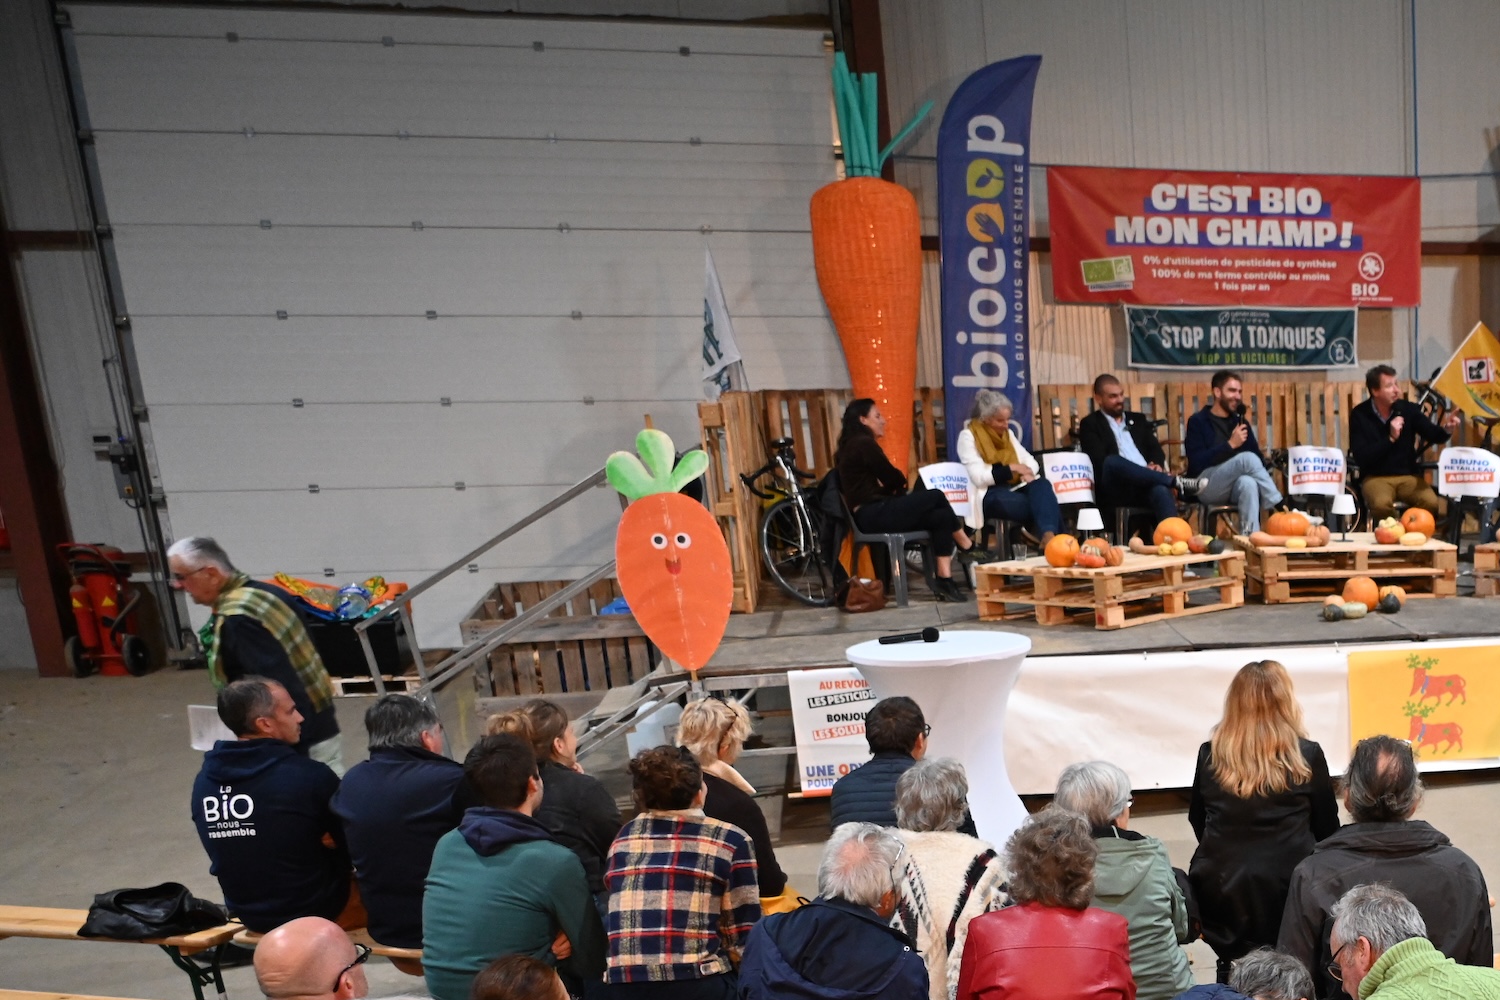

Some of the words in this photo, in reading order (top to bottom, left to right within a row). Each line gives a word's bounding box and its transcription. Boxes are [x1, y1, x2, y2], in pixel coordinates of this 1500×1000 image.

[1151, 183, 1252, 213] C'EST
[1259, 186, 1322, 215] BIO
[1013, 164, 1023, 270] RASSEMBLE
[1114, 216, 1199, 245] MON
[952, 115, 1024, 389] biocoop
[1143, 255, 1161, 265] 0%
[1163, 257, 1219, 266] d'utilisation
[1221, 257, 1232, 267] de
[1234, 257, 1281, 268] pesticides
[1282, 259, 1295, 268] de
[1296, 259, 1337, 270] synthèse
[1152, 268, 1182, 278] 100%
[1184, 269, 1196, 279] de
[1214, 270, 1242, 280] ferme
[1244, 271, 1288, 281] contrôlée
[1289, 273, 1300, 281] au
[1302, 272, 1330, 282] moins
[1214, 282, 1220, 290] 1
[1222, 282, 1239, 291] fois
[1241, 284, 1256, 292] par
[1258, 284, 1270, 292] an
[1352, 283, 1379, 296] BIO
[1014, 279, 1023, 323] NOUS
[1162, 326, 1204, 349] STOP
[1210, 326, 1242, 349] AUX
[1247, 326, 1326, 350] TOXIQUES
[1015, 332, 1024, 361] BIO
[1225, 352, 1236, 364] DE
[1242, 352, 1287, 364] VICTIMES
[1017, 370, 1025, 389] LA
[1293, 457, 1342, 466] MARINE
[1450, 458, 1490, 466] BRUNO
[1448, 473, 1492, 482] ABSENT
[819, 682, 832, 690] AU
[809, 696, 827, 708] LES
[827, 690, 876, 705] PESTICIDE
[827, 712, 868, 722] BONJOU
[813, 730, 832, 740] LES
[832, 724, 866, 738] SOLUTI
[806, 764, 836, 777] UNE
[808, 778, 834, 788] POUR
[217, 820, 240, 829] nous
[208, 828, 256, 838] rassemble
